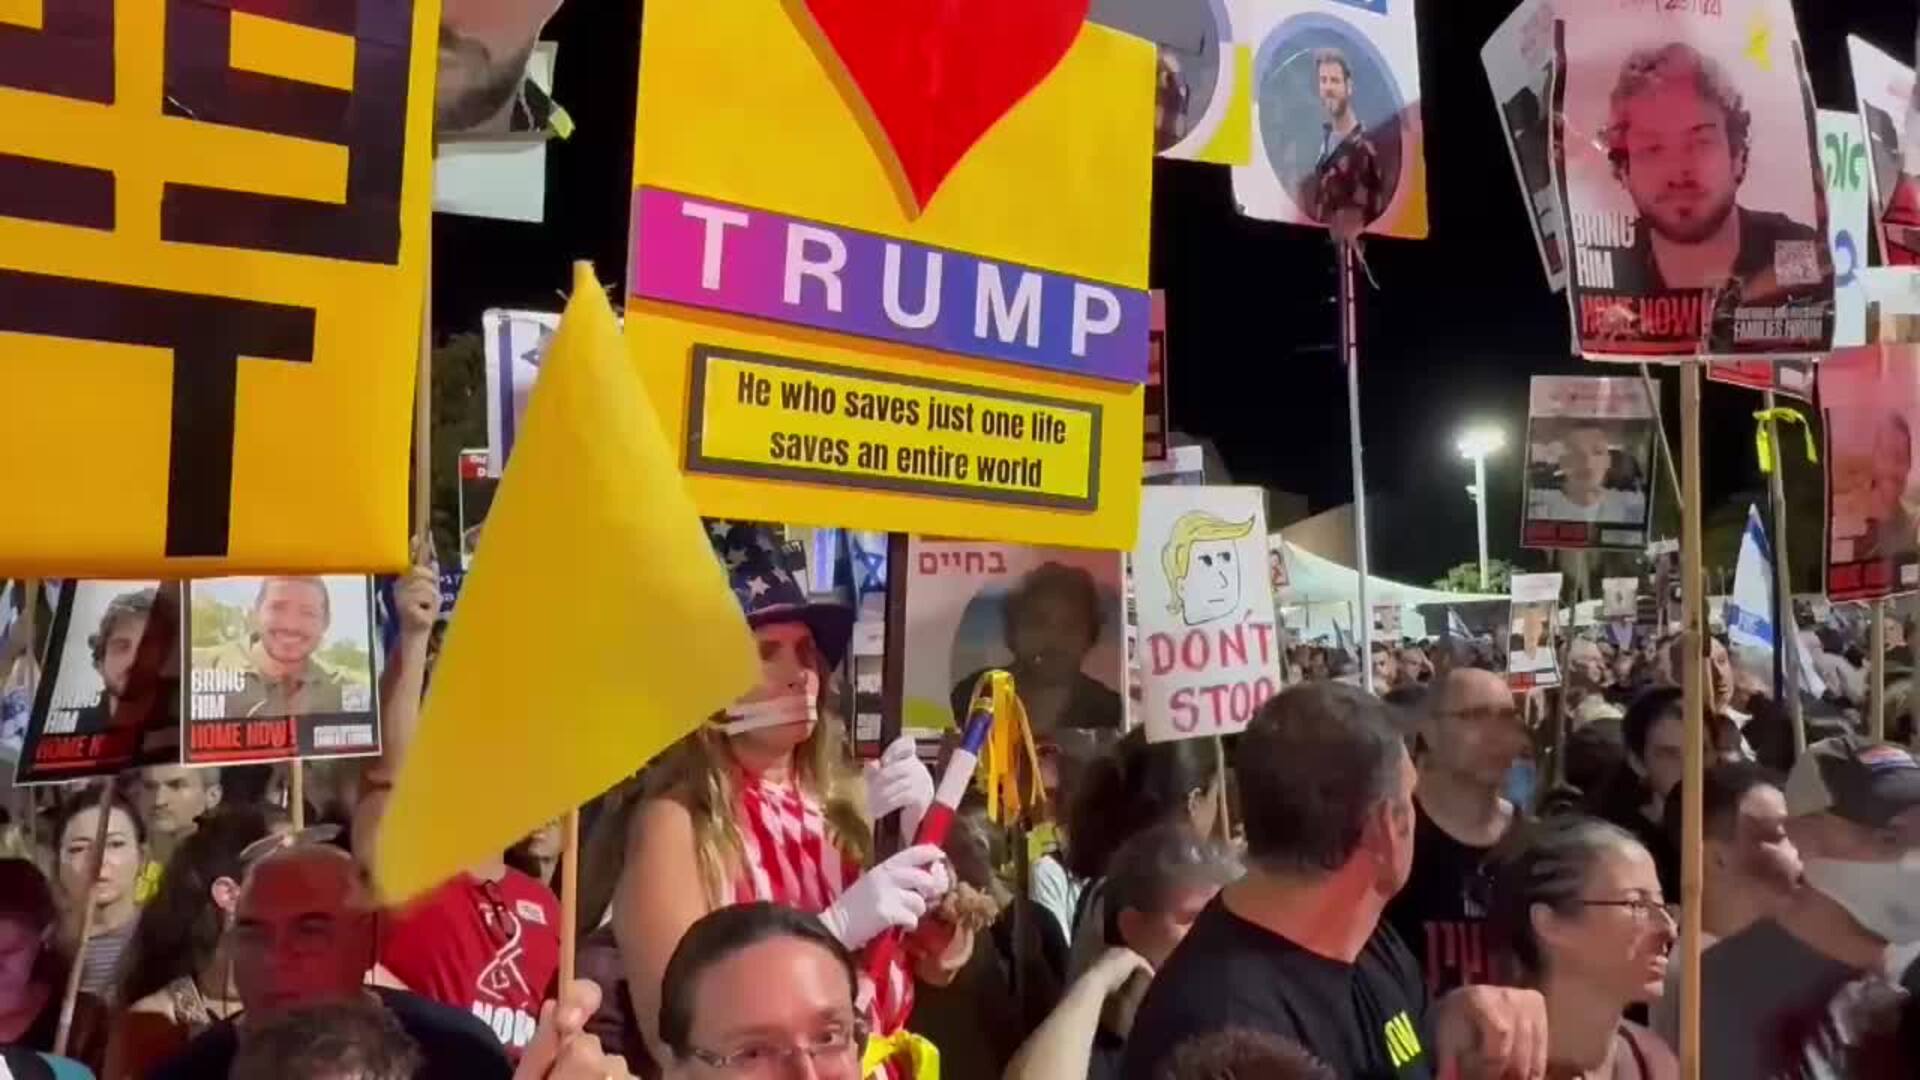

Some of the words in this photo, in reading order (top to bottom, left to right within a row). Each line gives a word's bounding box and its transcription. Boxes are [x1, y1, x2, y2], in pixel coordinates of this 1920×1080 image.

[1574, 211, 1635, 248] BRING
[681, 201, 1122, 357] TRUMP
[1577, 248, 1615, 288] HIM
[737, 371, 771, 407] He
[781, 380, 837, 415] who
[844, 391, 920, 426] saves
[927, 396, 974, 432] just
[981, 409, 1025, 440] one
[1031, 411, 1067, 445] life
[770, 431, 849, 467] saves
[857, 441, 889, 472] an
[897, 445, 969, 480] entire
[976, 455, 1043, 488] world
[918, 550, 1008, 575] בחיים
[1147, 608, 1273, 676] DON'T
[192, 667, 246, 693] BRING
[1169, 677, 1275, 733] STOP
[191, 722, 242, 749] HOME
